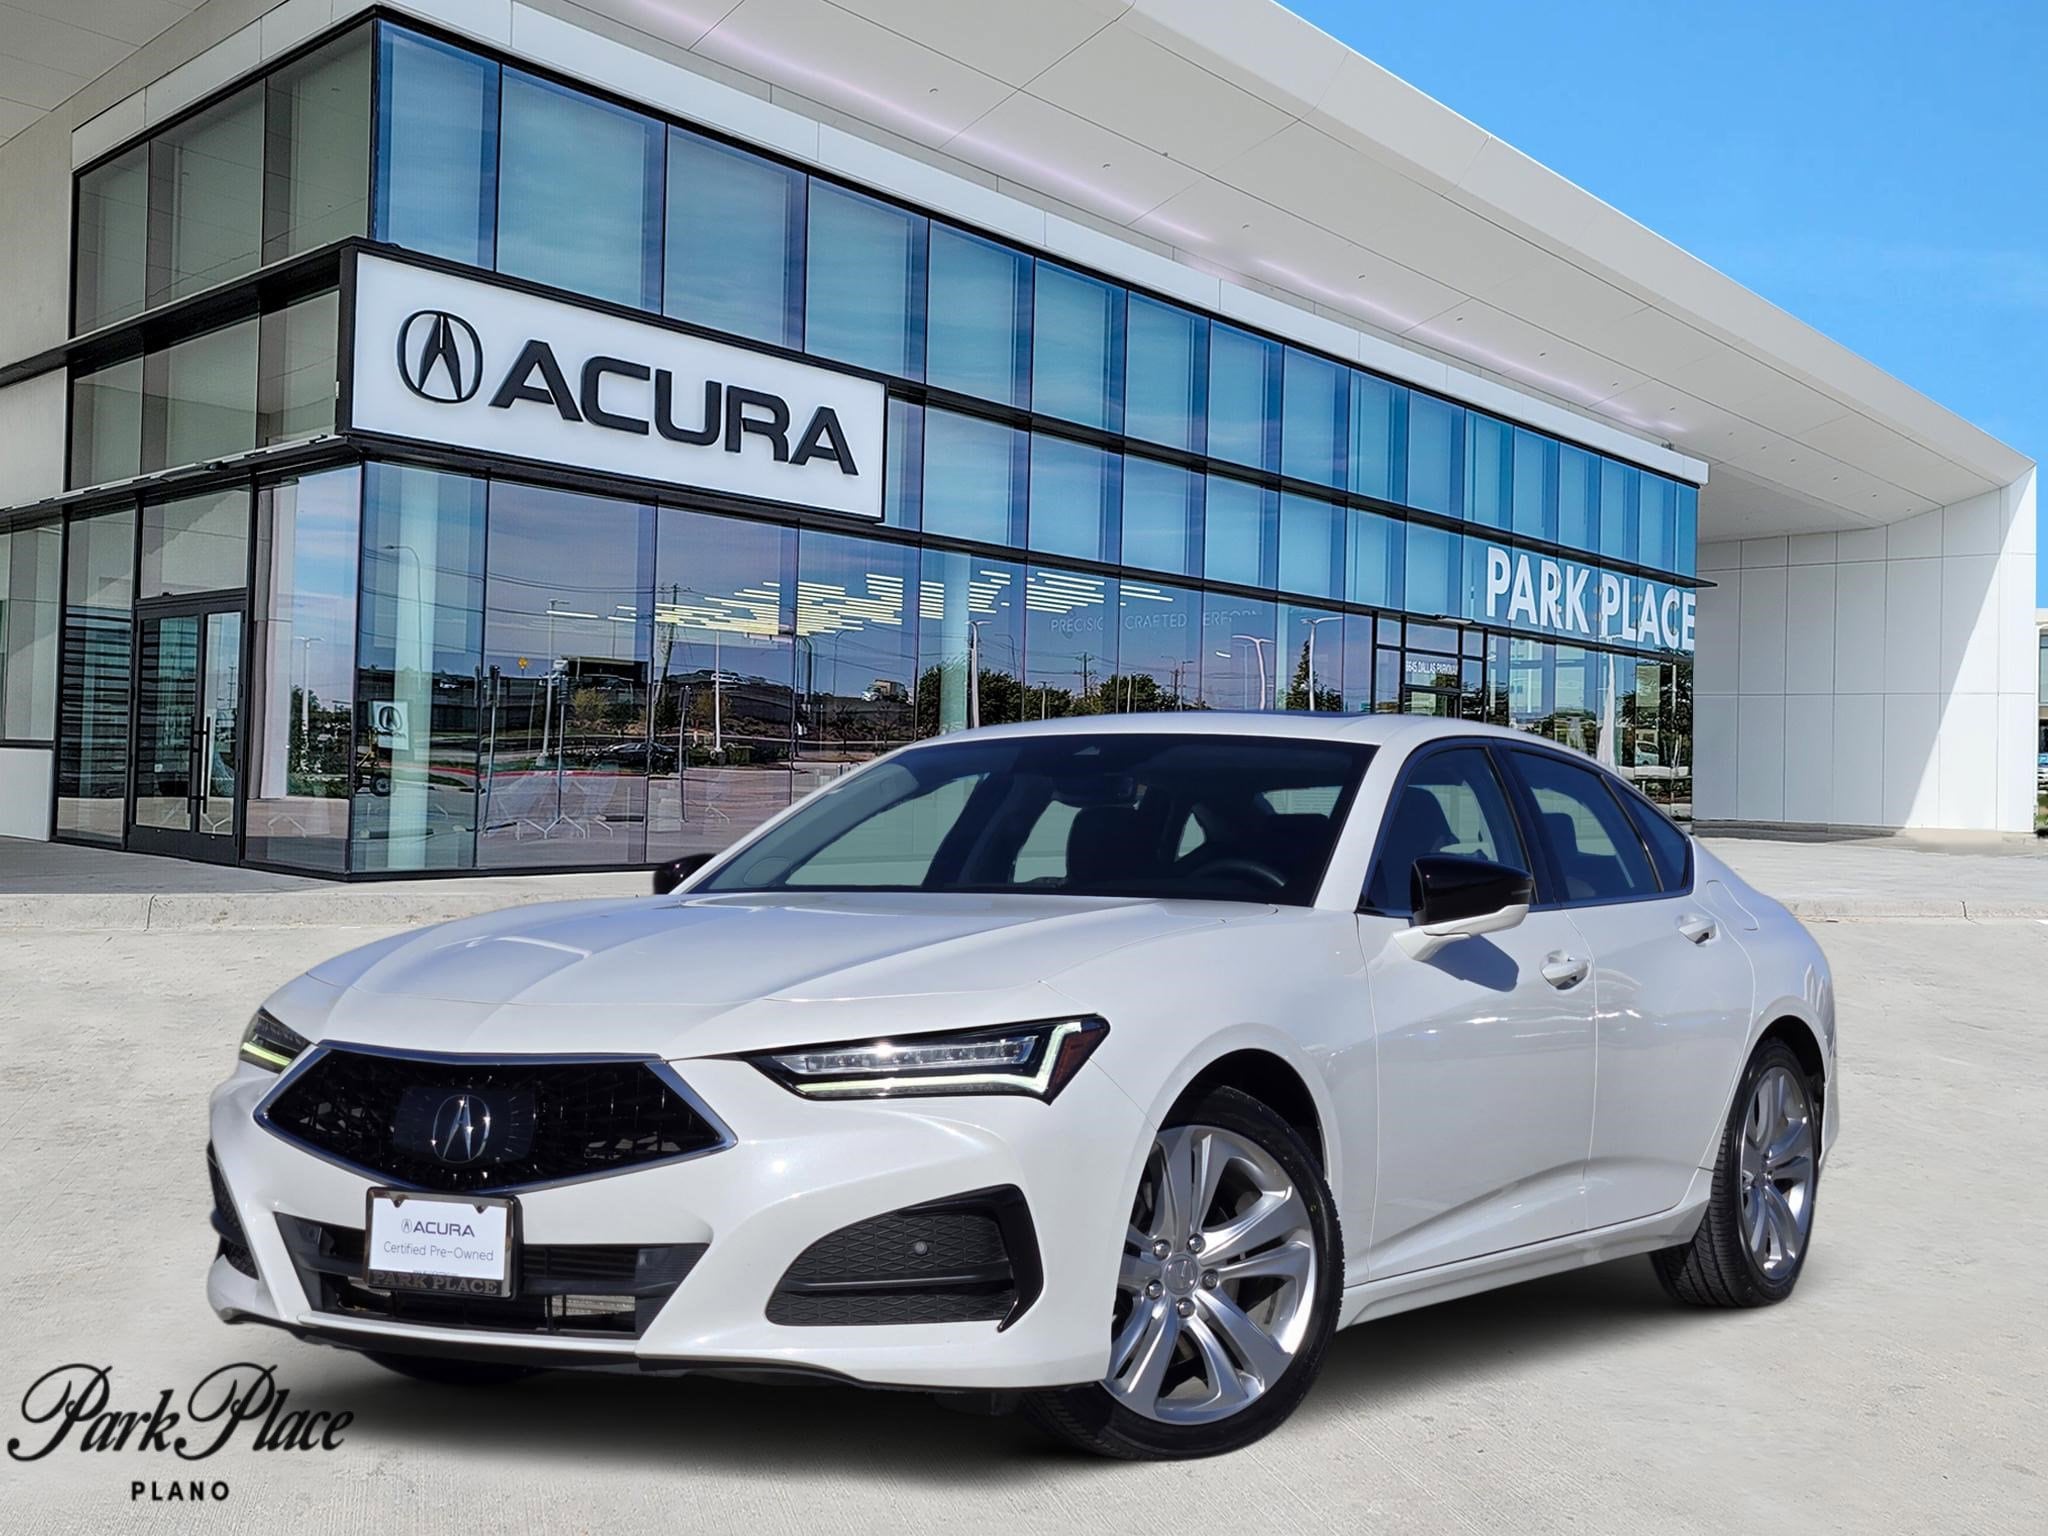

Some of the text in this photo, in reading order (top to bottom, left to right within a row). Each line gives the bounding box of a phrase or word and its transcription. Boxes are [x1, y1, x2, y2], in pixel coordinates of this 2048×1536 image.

[488, 338, 860, 477] ACURA
[1486, 546, 1696, 650] PARK PLACE
[1050, 616, 1104, 632] PRECISIO
[413, 1221, 476, 1238] ACURA
[383, 1240, 494, 1262] Certified Pre-Owned
[373, 1270, 428, 1289] PARK
[431, 1276, 499, 1295] PLACE
